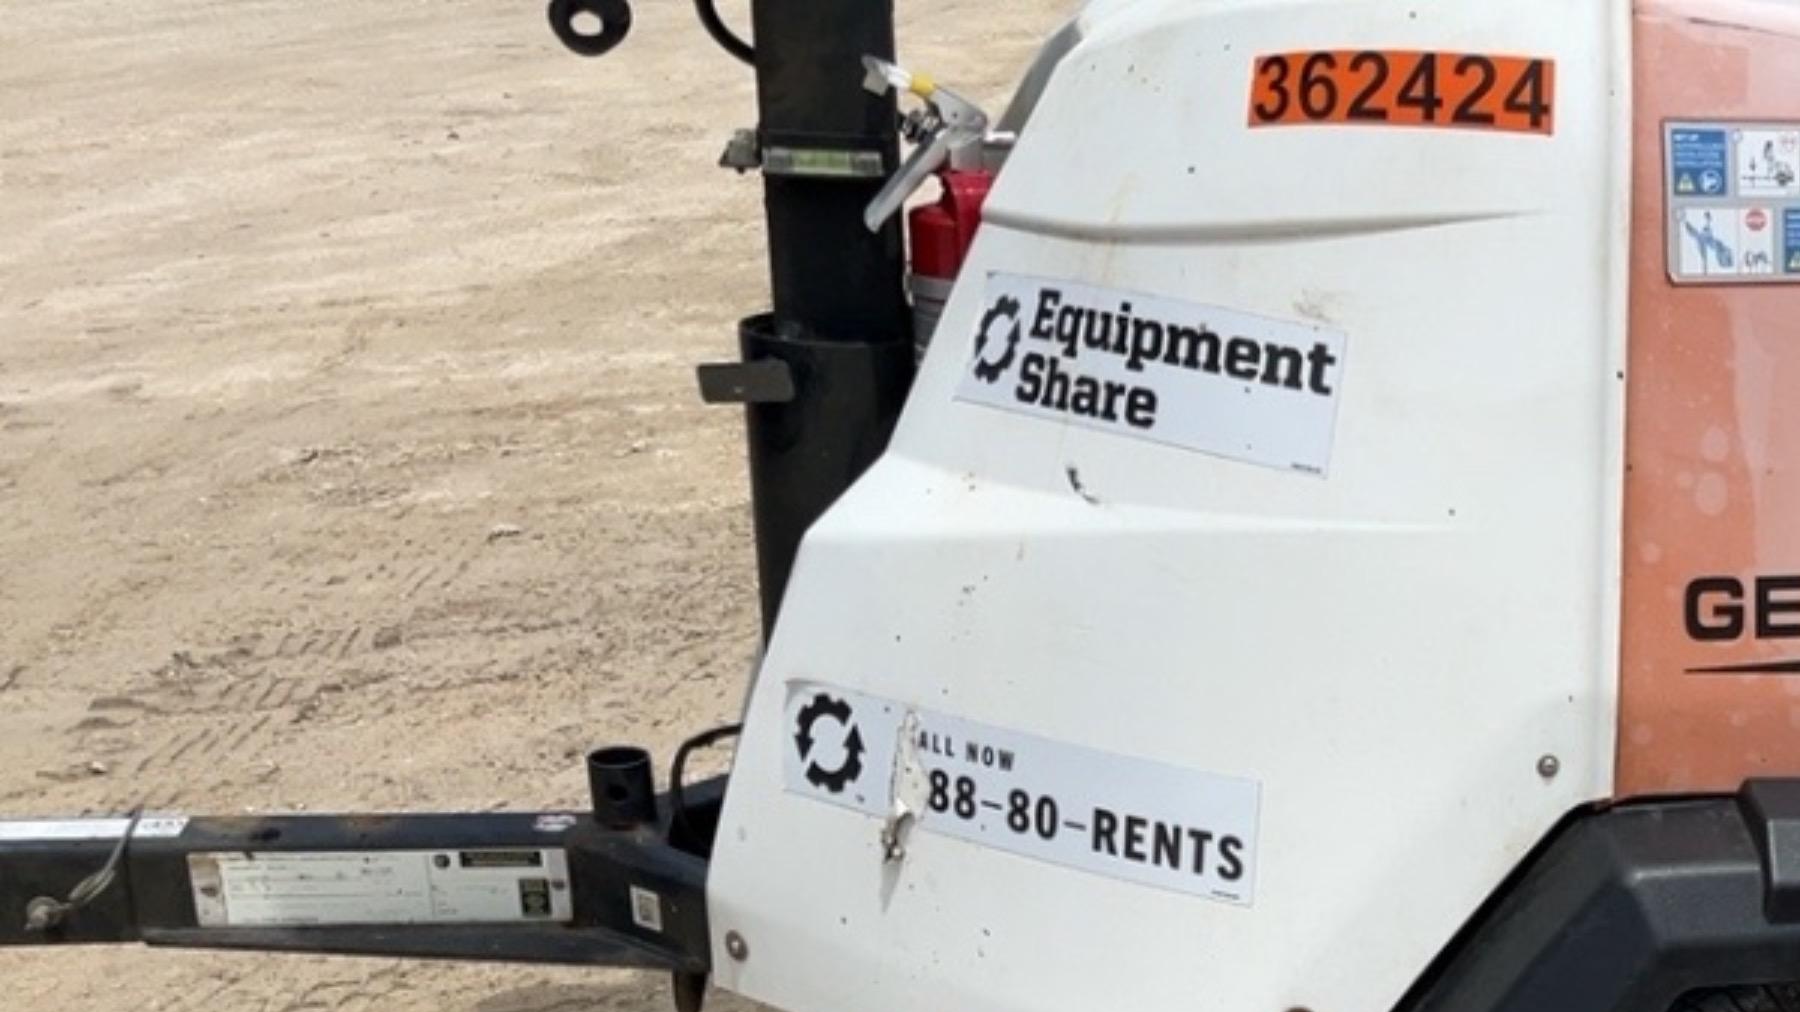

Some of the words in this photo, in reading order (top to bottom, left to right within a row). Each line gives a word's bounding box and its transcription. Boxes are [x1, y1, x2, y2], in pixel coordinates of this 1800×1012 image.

[1254, 51, 1551, 129] 362424
[1029, 287, 1337, 397] Equipment
[1015, 350, 1159, 430] Share
[916, 730, 956, 758] ALL
[964, 741, 1015, 772] NOW
[927, 768, 1243, 881] 88-80-RENTS
